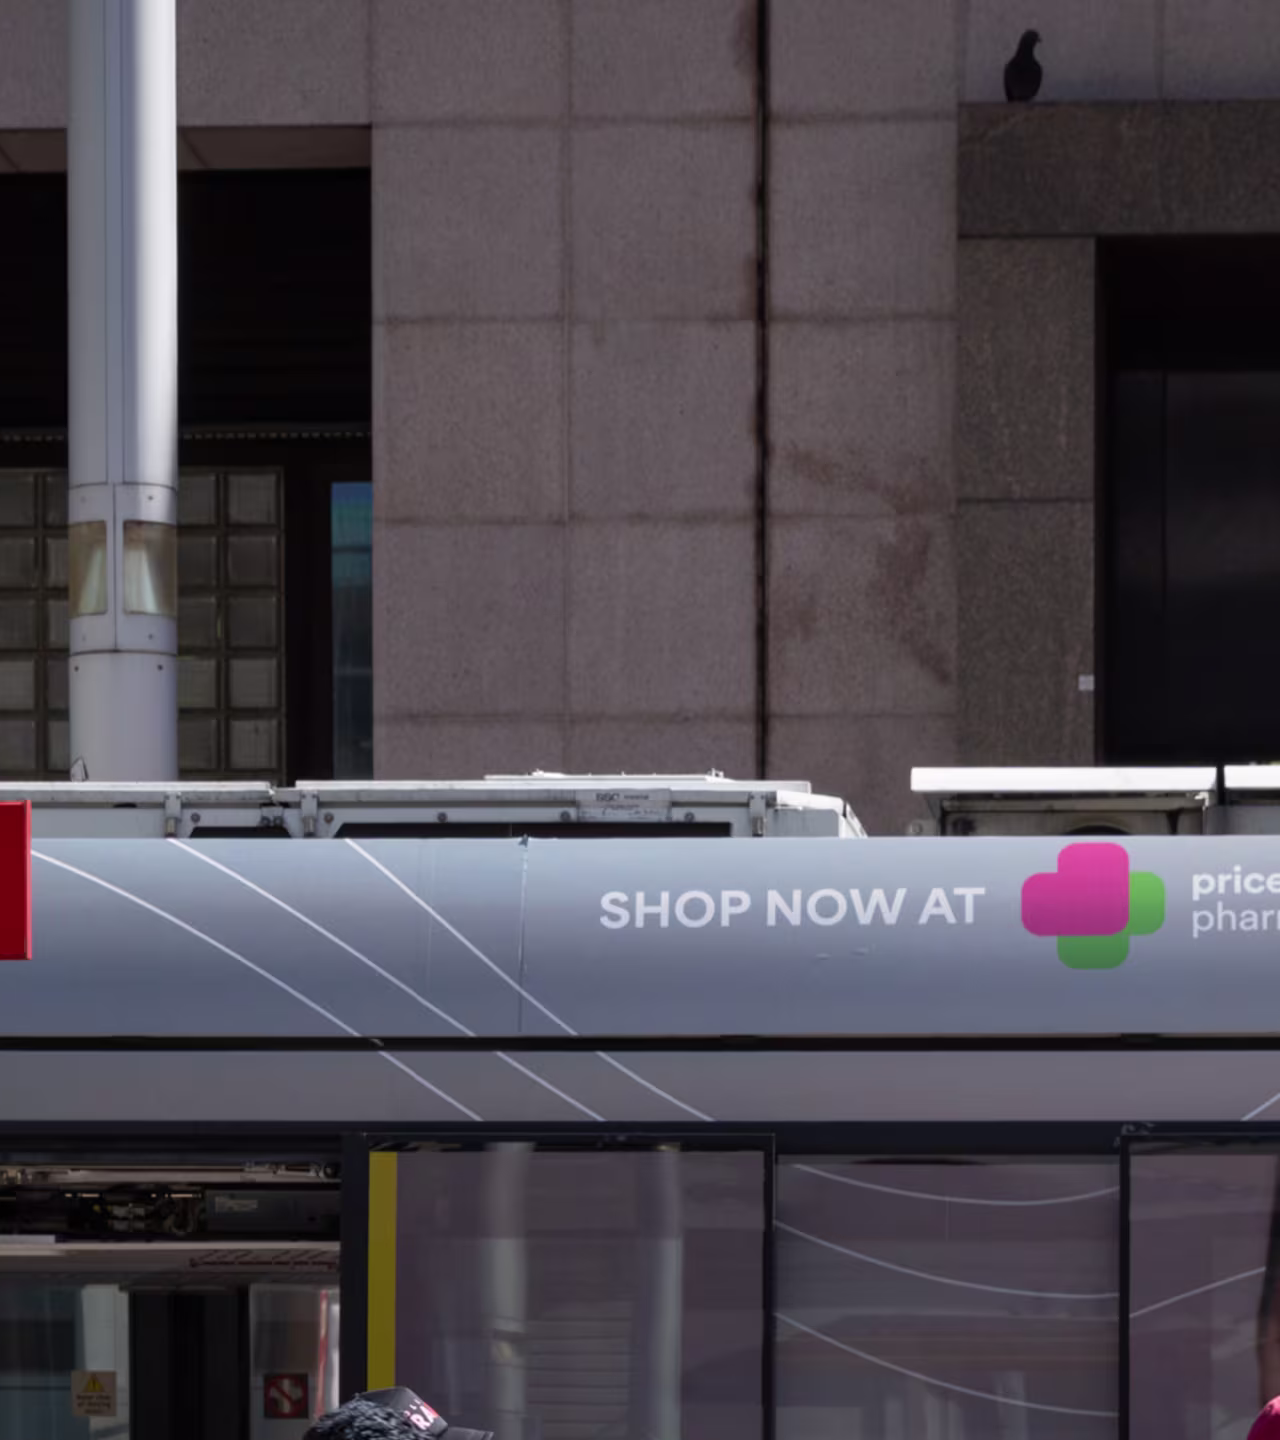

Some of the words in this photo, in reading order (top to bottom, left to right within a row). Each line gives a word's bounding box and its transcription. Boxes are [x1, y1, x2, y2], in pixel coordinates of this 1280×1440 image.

[600, 887, 751, 929] SHOP
[765, 886, 908, 927] NOW
[918, 885, 986, 925] AT
